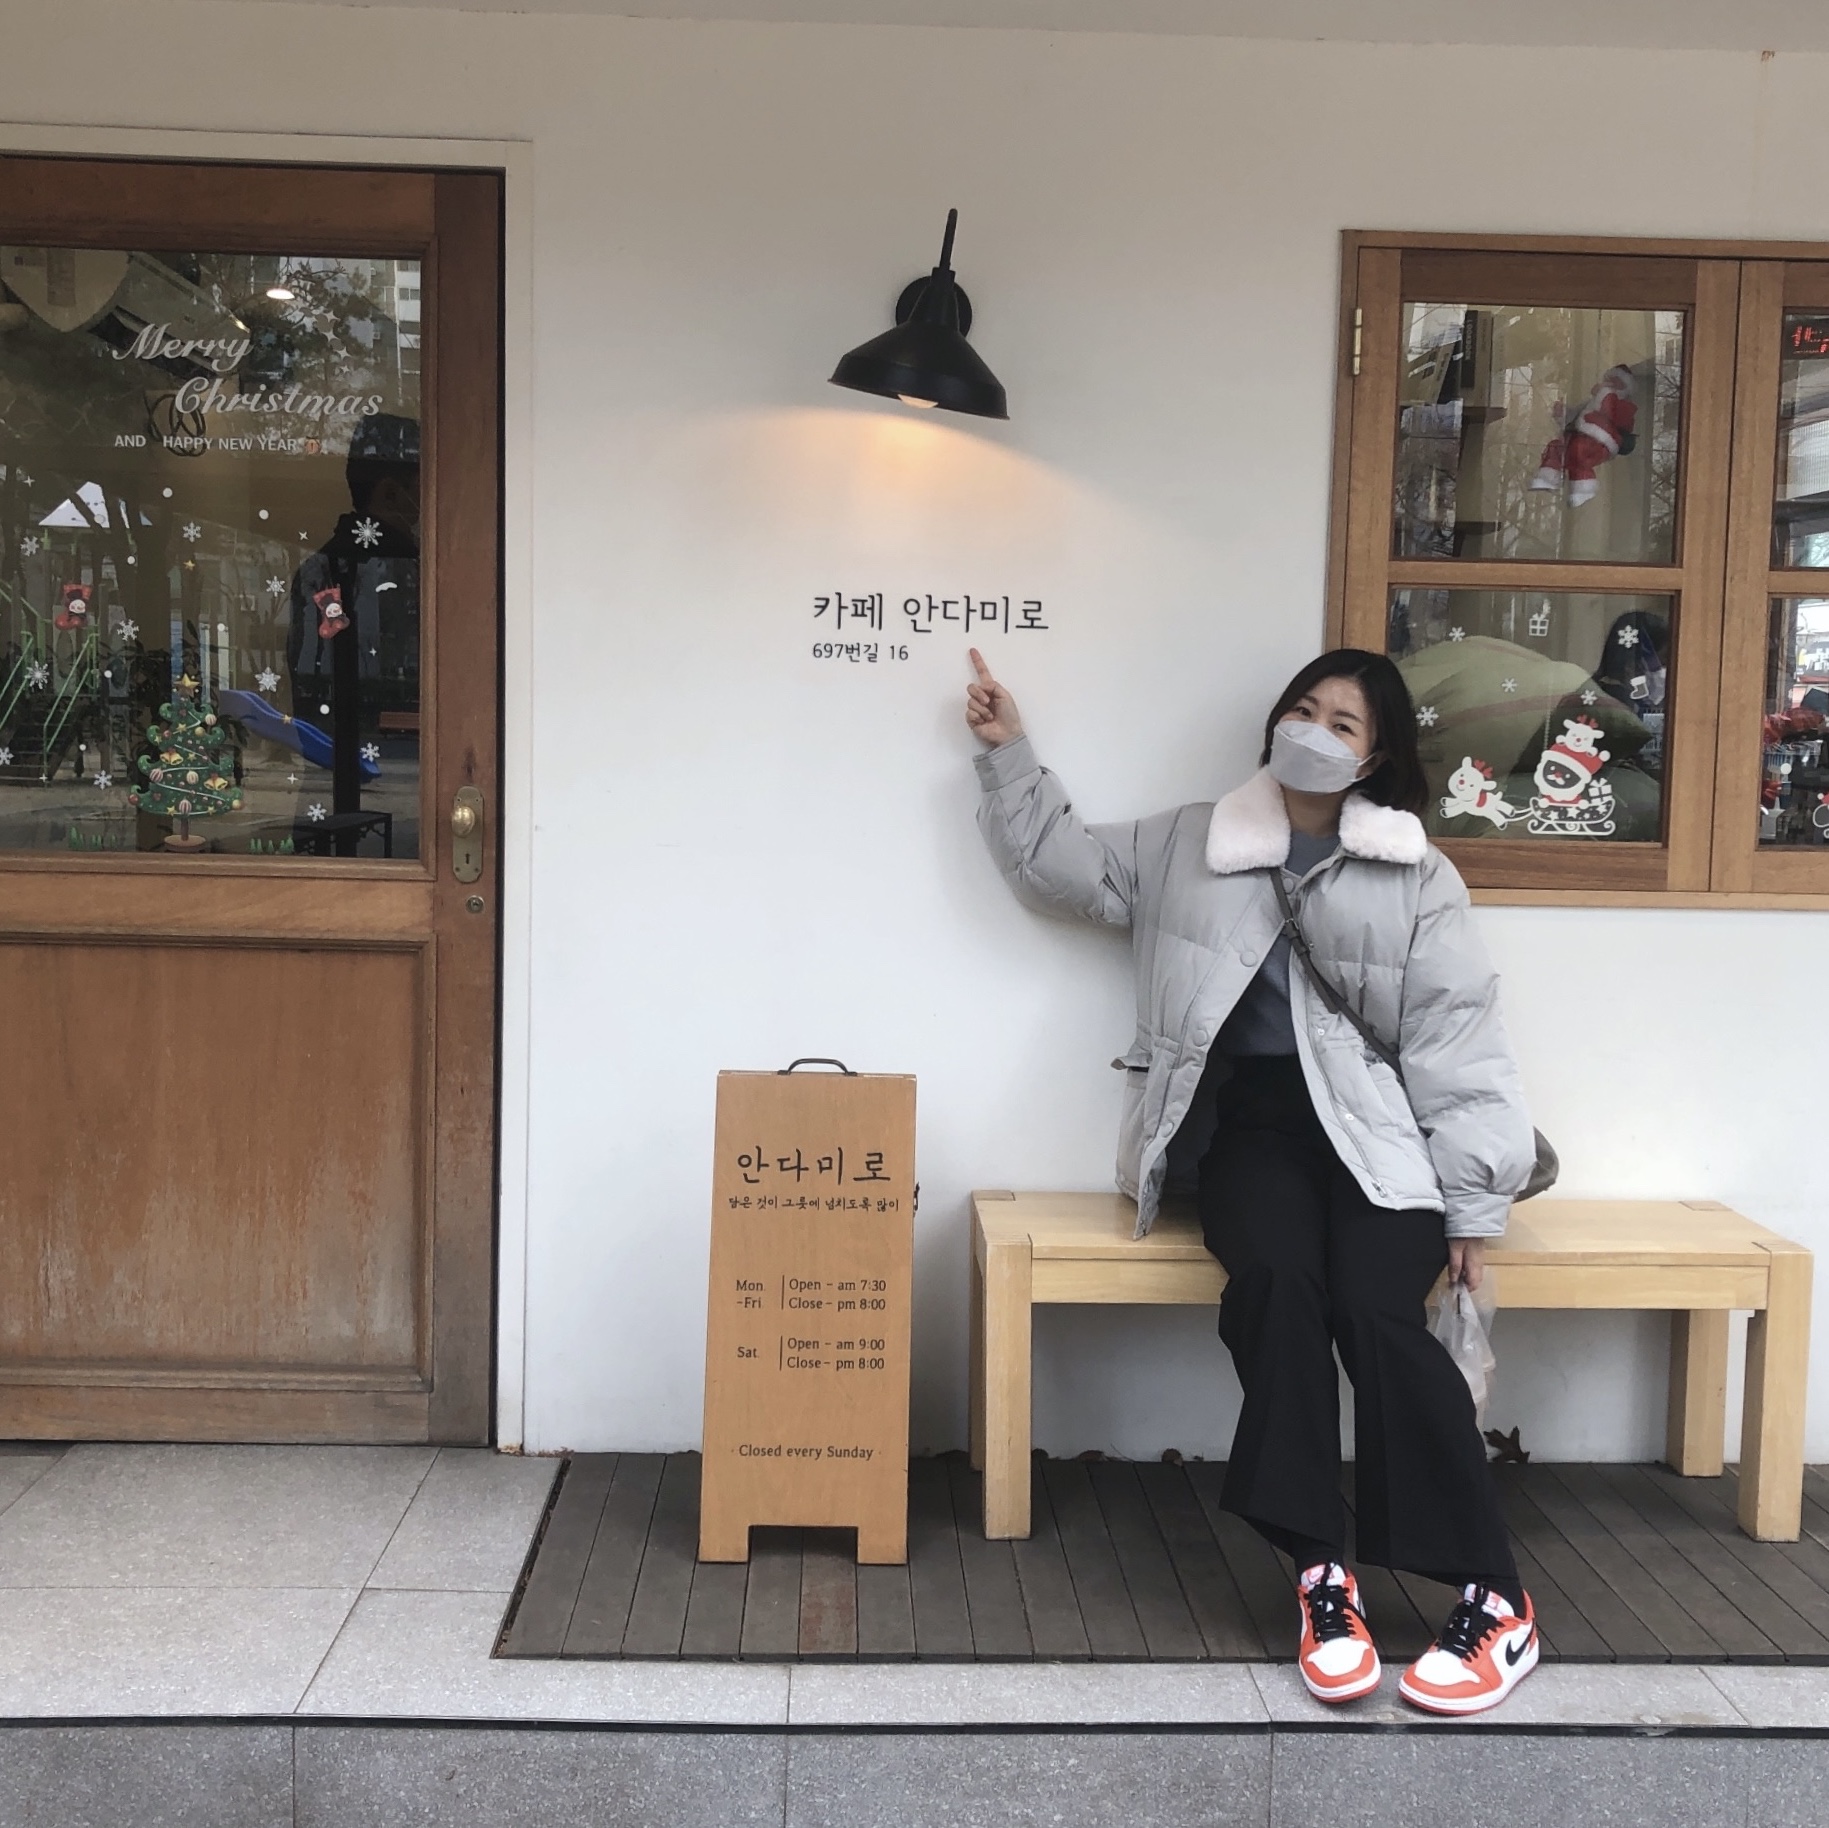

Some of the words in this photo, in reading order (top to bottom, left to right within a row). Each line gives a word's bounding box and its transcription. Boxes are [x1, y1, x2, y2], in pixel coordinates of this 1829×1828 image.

[112, 322, 254, 373] Merry
[175, 376, 384, 415] Christmas
[114, 435, 147, 448] AND
[163, 436, 214, 449] HAPPY
[219, 438, 252, 450] NEW
[813, 591, 884, 631] 카페
[903, 593, 1049, 634] 안다미로
[812, 642, 879, 663] 697번길
[889, 645, 909, 661] 16
[737, 1145, 891, 1186] 안다미로
[728, 1195, 753, 1209] 담은
[757, 1195, 778, 1210] 것이
[781, 1196, 820, 1211] 그릇에
[824, 1196, 872, 1212] 넘치도록
[876, 1197, 899, 1213] 많이
[789, 1278, 821, 1293] Open
[837, 1281, 856, 1291] am
[860, 1280, 887, 1292] 7:30
[837, 1300, 856, 1312] pm
[859, 1298, 886, 1311] 8:00
[787, 1337, 820, 1352] Open
[836, 1340, 855, 1350] am
[858, 1339, 885, 1351] 9:00
[836, 1359, 855, 1371] pm
[858, 1357, 885, 1370] 8:00
[738, 1444, 782, 1457] Closed
[786, 1447, 823, 1461] every
[827, 1445, 874, 1461] Sunday
